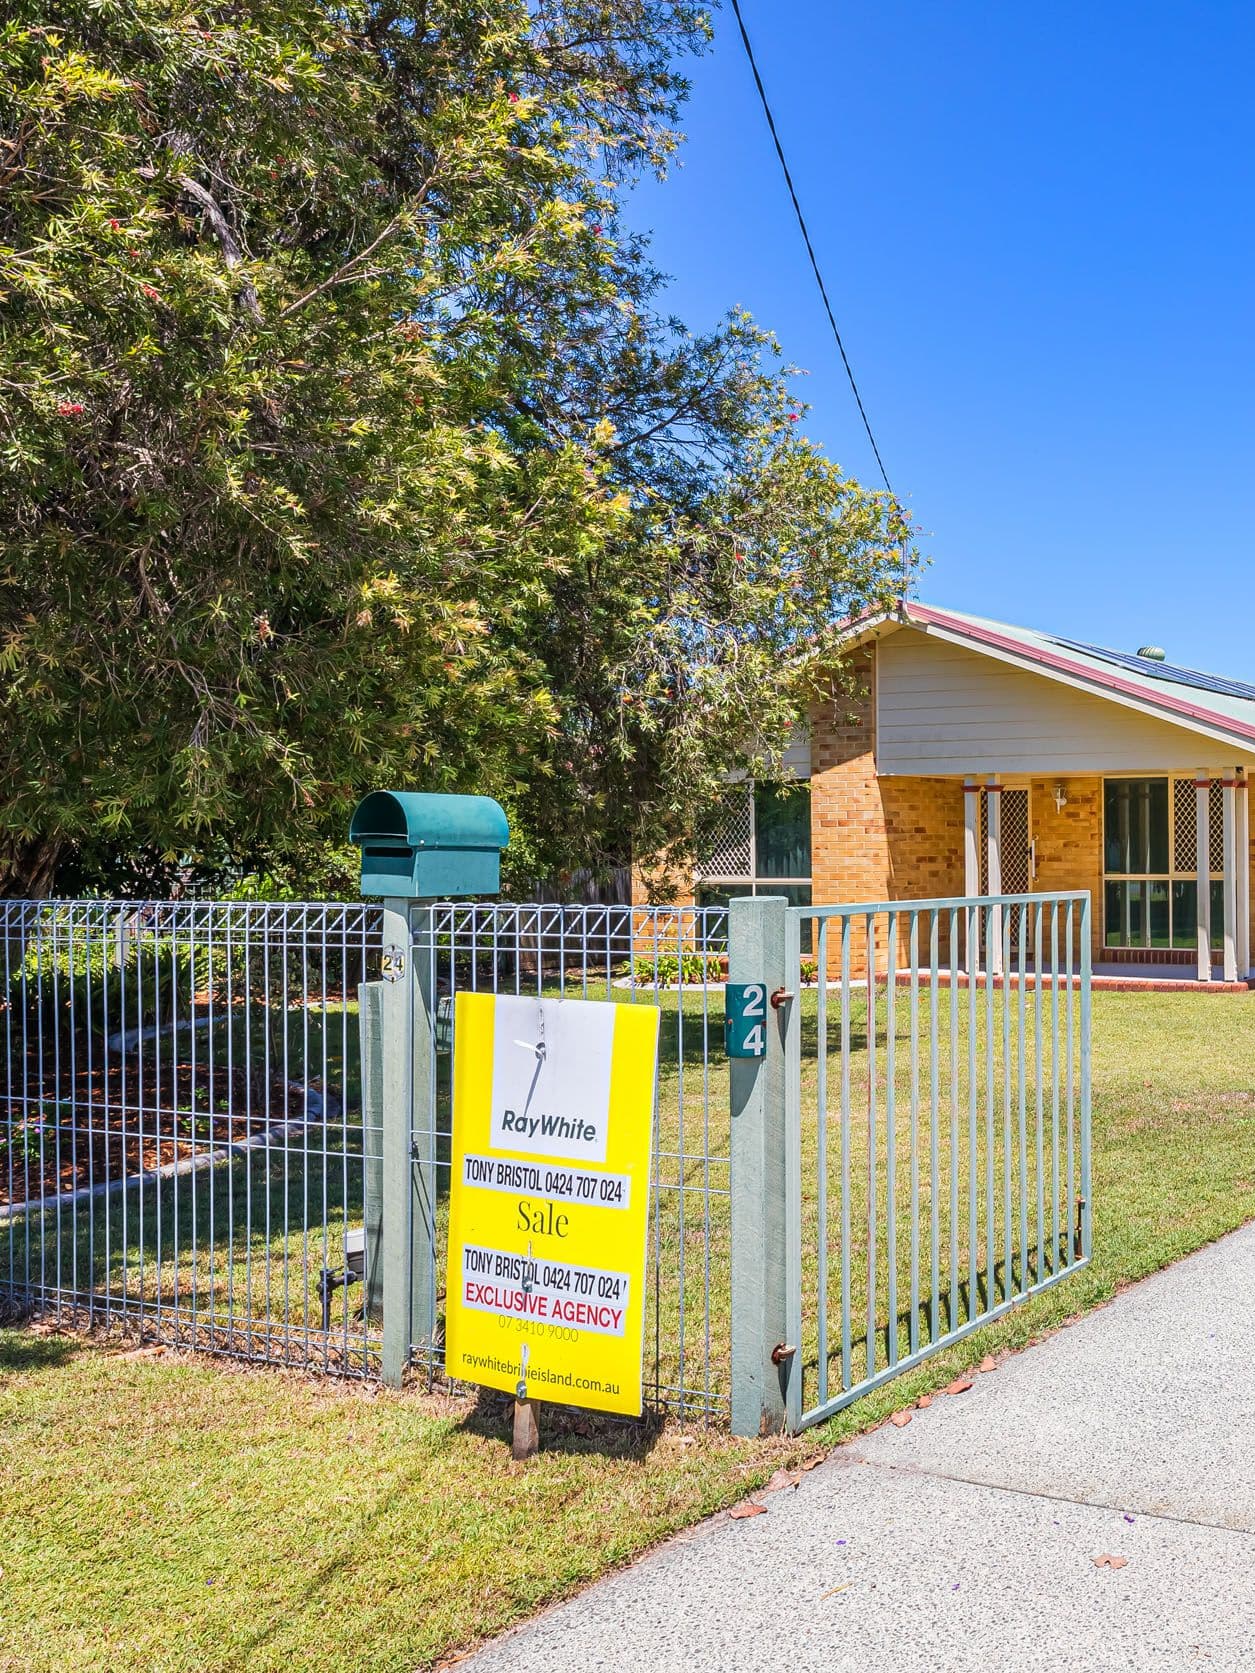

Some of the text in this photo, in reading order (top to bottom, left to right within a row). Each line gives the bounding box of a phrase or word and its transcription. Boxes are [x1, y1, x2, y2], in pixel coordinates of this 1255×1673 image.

[384, 955, 403, 971] 24
[466, 1158, 623, 1202] TONY BRISTOL 0424 707 024
[517, 1200, 569, 1238] Sale
[465, 1248, 621, 1300] TONY BRISTOL 0424 707 024
[465, 1282, 623, 1329] EXCLUSIVE AGENCY
[498, 1314, 579, 1343] 07 3410 9000
